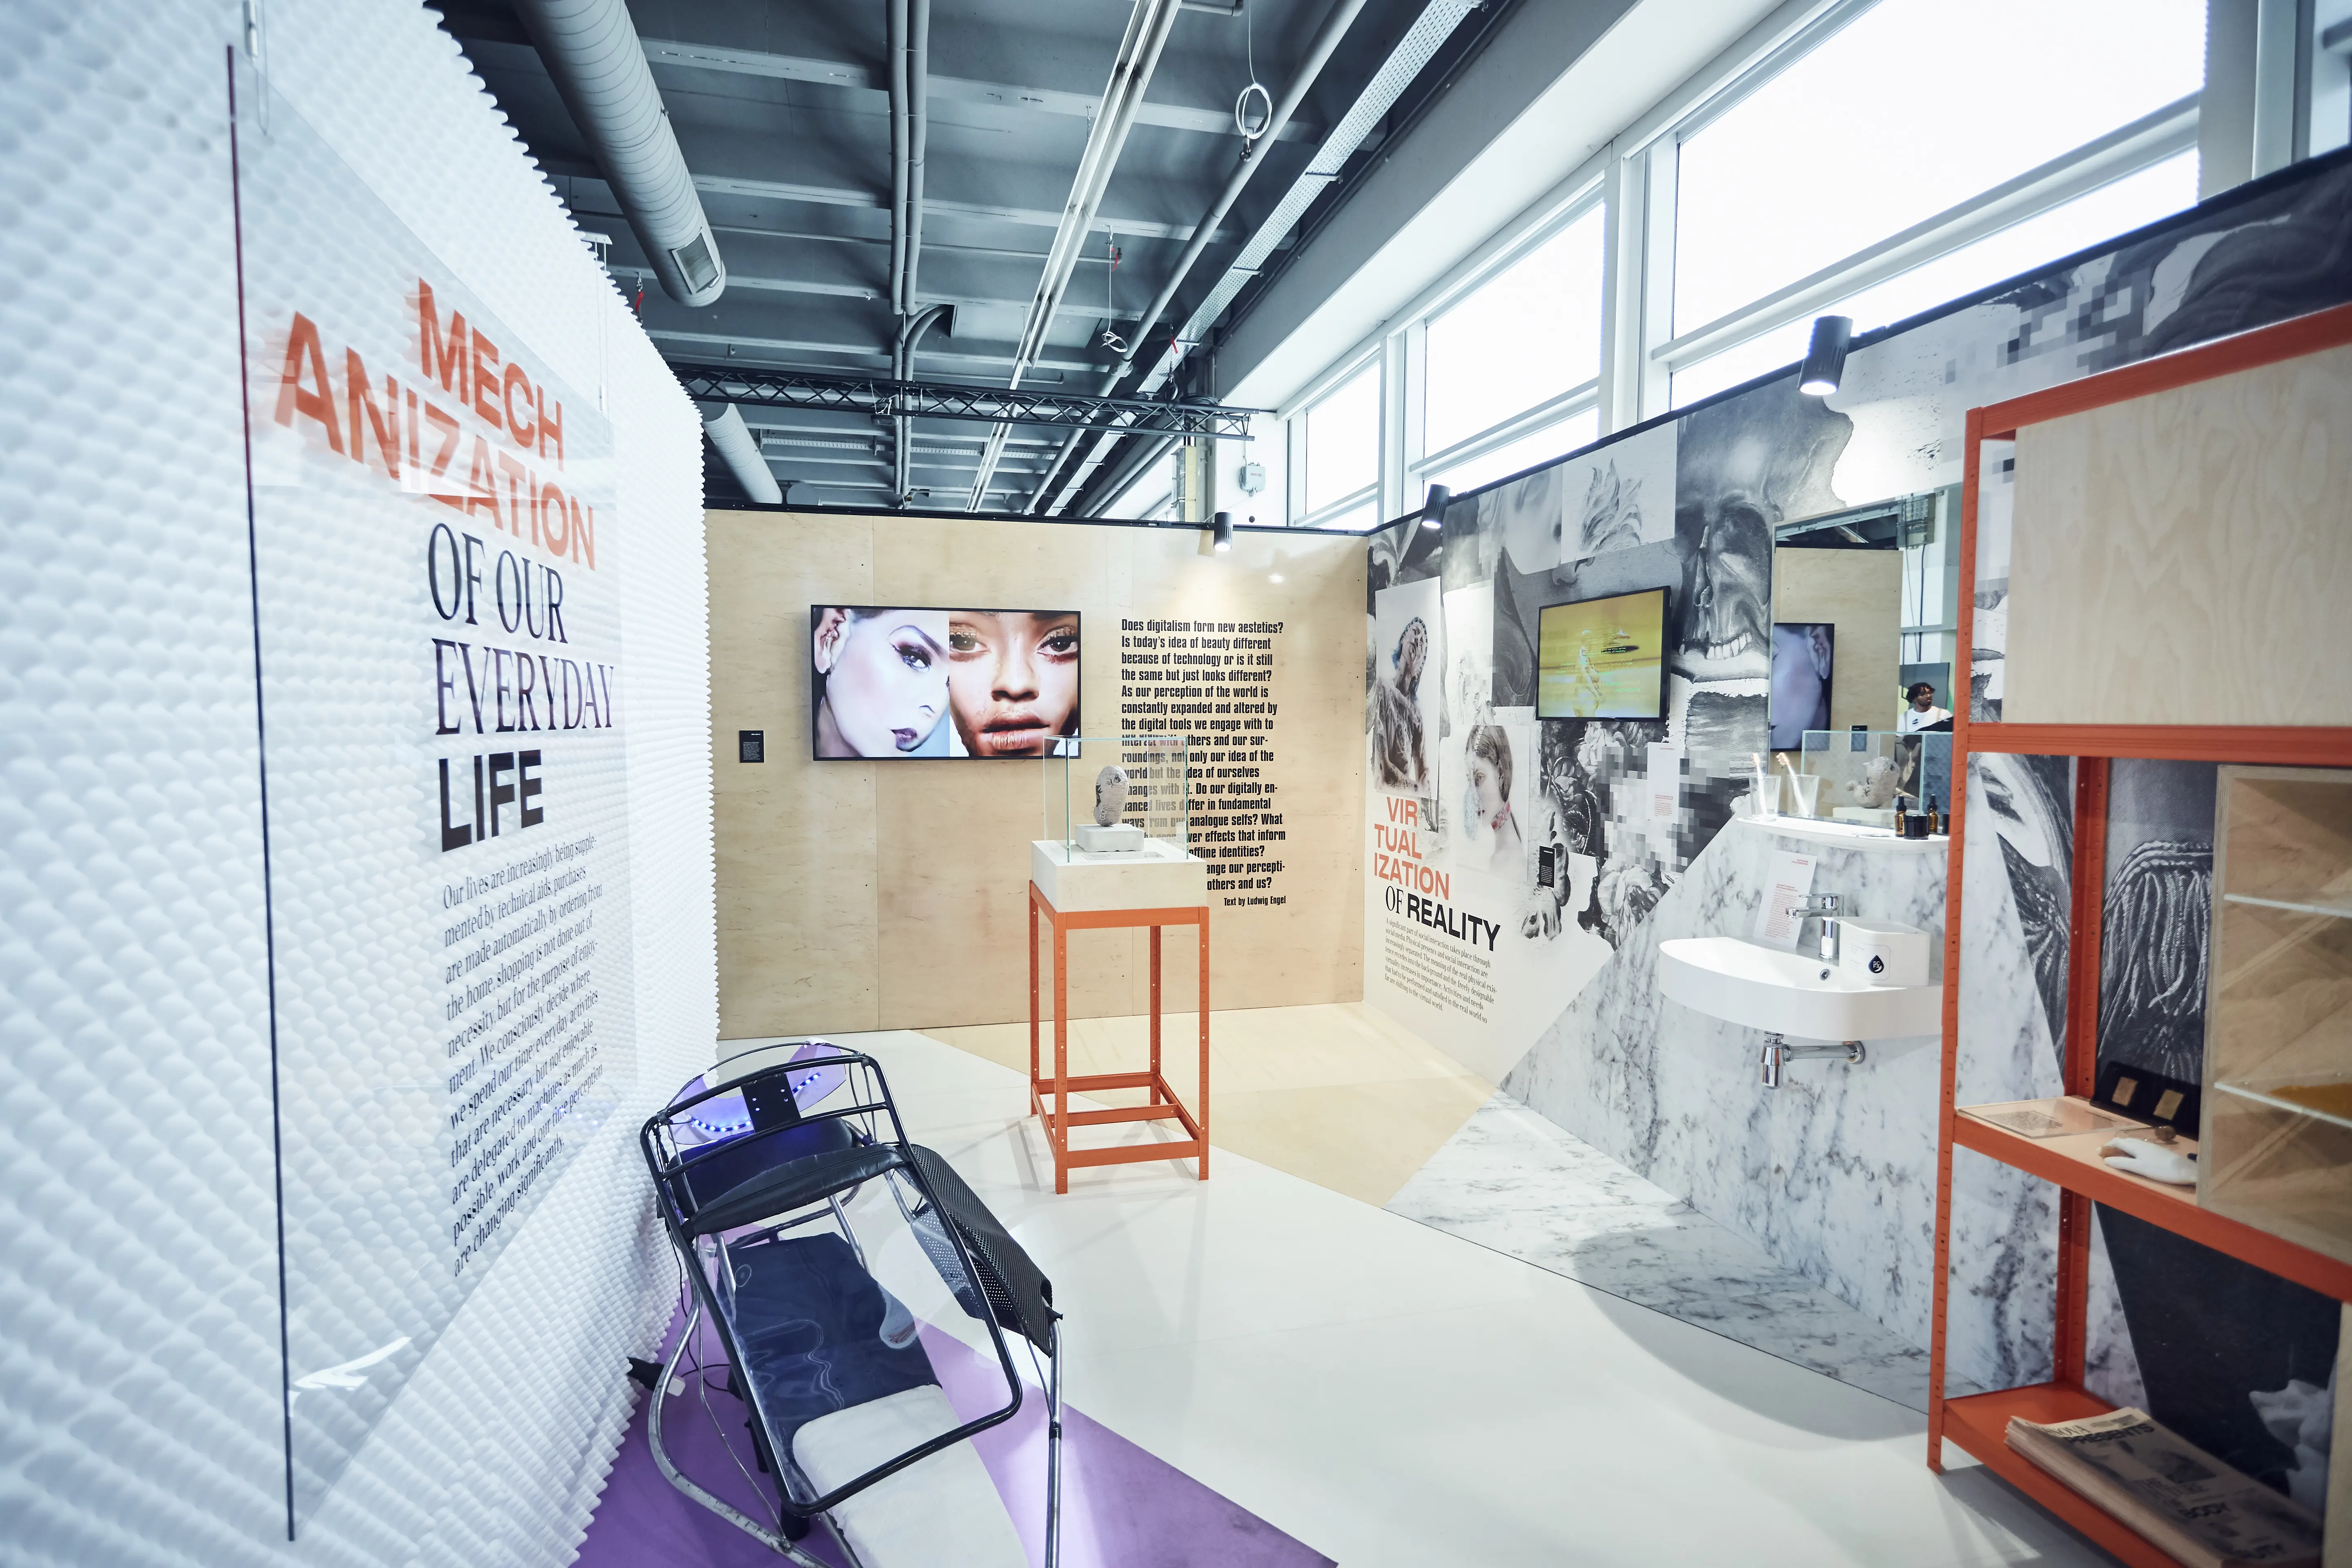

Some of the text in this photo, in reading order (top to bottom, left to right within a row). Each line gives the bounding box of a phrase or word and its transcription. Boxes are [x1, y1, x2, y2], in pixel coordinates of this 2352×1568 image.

[419, 276, 564, 472] MECH
[274, 310, 596, 571] ANIZATION
[428, 523, 568, 644] OF OUR
[1122, 619, 1283, 633] Does digitalism form new aestetics?
[1122, 635, 1271, 650] Is today's idea of beauty different
[1122, 652, 1272, 666] because of technology or is it still
[1121, 668, 1271, 682] the same but just looks different?
[432, 638, 614, 735] EVERYDAY
[1121, 685, 1268, 699] As our perception of the world is
[1122, 702, 1277, 715] constantly expanded and altered by
[1121, 718, 1273, 731] the digital tools we engage with to
[1214, 734, 1229, 745] and
[1232, 736, 1247, 745] our
[1250, 736, 1267, 745] sur-
[1189, 750, 1207, 764] only
[1210, 752, 1225, 762] our
[1228, 750, 1246, 761] idea
[1250, 750, 1257, 761] of
[1260, 750, 1273, 761] the
[1149, 767, 1164, 779] but
[1167, 767, 1180, 778] the
[1206, 766, 1214, 777] of
[1217, 766, 1259, 777] ourselves
[1128, 784, 1158, 797] hanges
[1160, 783, 1179, 795] with
[1196, 783, 1207, 794] Do
[1210, 784, 1225, 793] our
[1228, 782, 1262, 795] digitally
[1265, 784, 1277, 793] en-
[439, 749, 544, 853] LIFE
[1208, 799, 1215, 810] in
[1218, 797, 1270, 810] fundamental
[1387, 797, 1418, 827] VIR
[1189, 815, 1228, 828] analogue
[1232, 813, 1258, 825] selfs?
[1261, 813, 1282, 824] What
[1205, 829, 1285, 842] effects that inform
[1374, 824, 1422, 859] TUAL
[1219, 845, 1264, 857] identities?
[443, 832, 596, 909] Our lives are increasingly being supple-
[1229, 864, 1243, 873] our
[1247, 860, 1285, 874] percepti-
[1207, 877, 1272, 890] others and us?
[1374, 852, 1449, 900] IZATION
[445, 906, 482, 947] mented
[484, 904, 494, 929] by
[498, 882, 535, 920] technical
[554, 866, 586, 897] purchases
[1224, 895, 1286, 906] Text by Ludwig Engel
[1385, 886, 1501, 952] OF REALITY
[446, 884, 602, 984] are made automatically by ordering from
[2064, 1423, 2154, 1444] PRESENTS
